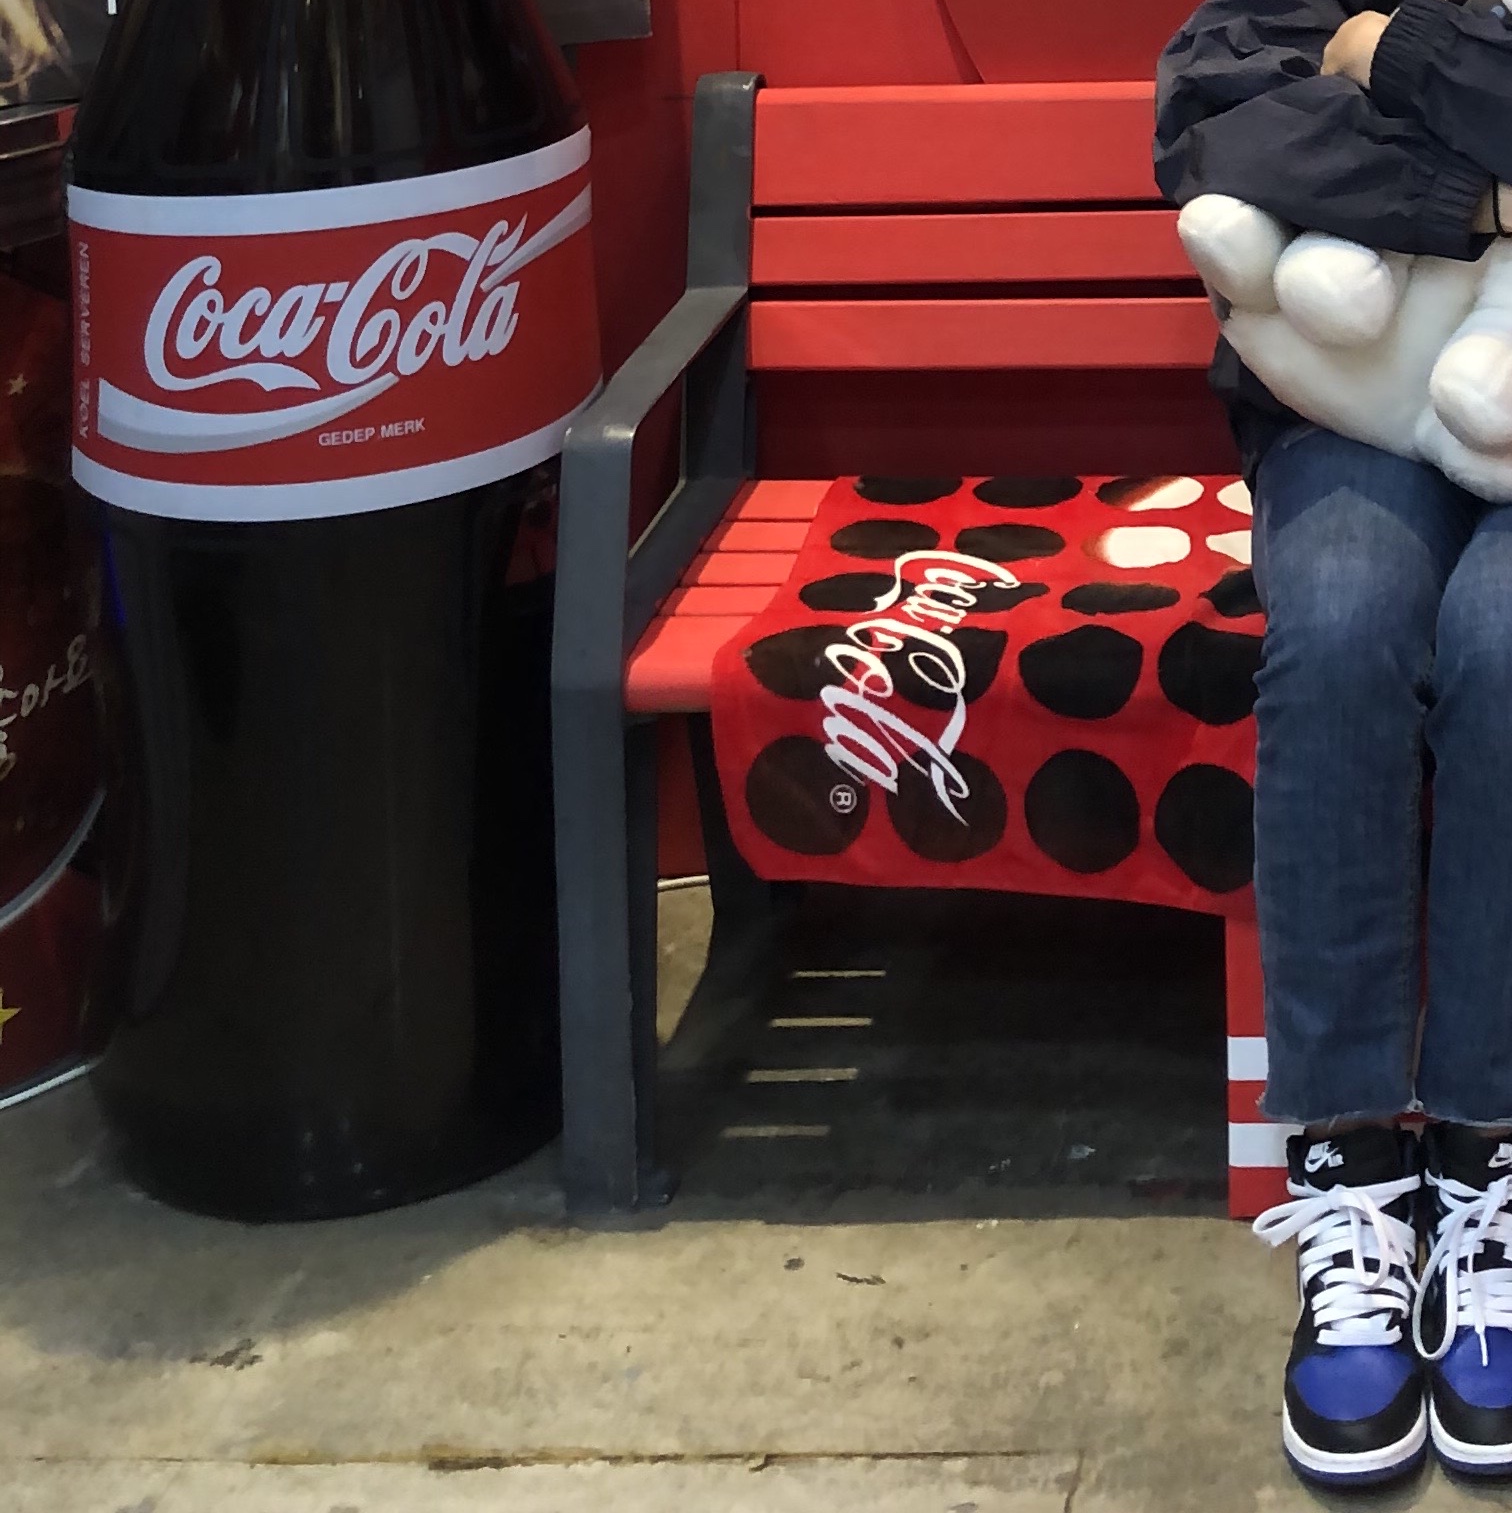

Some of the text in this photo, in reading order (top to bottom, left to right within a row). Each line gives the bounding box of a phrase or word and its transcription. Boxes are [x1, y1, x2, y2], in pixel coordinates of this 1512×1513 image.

[144, 212, 528, 392] Coca-Cola
[318, 417, 426, 447] GEDEP MERK
[820, 549, 1021, 827] Coca-Cola
